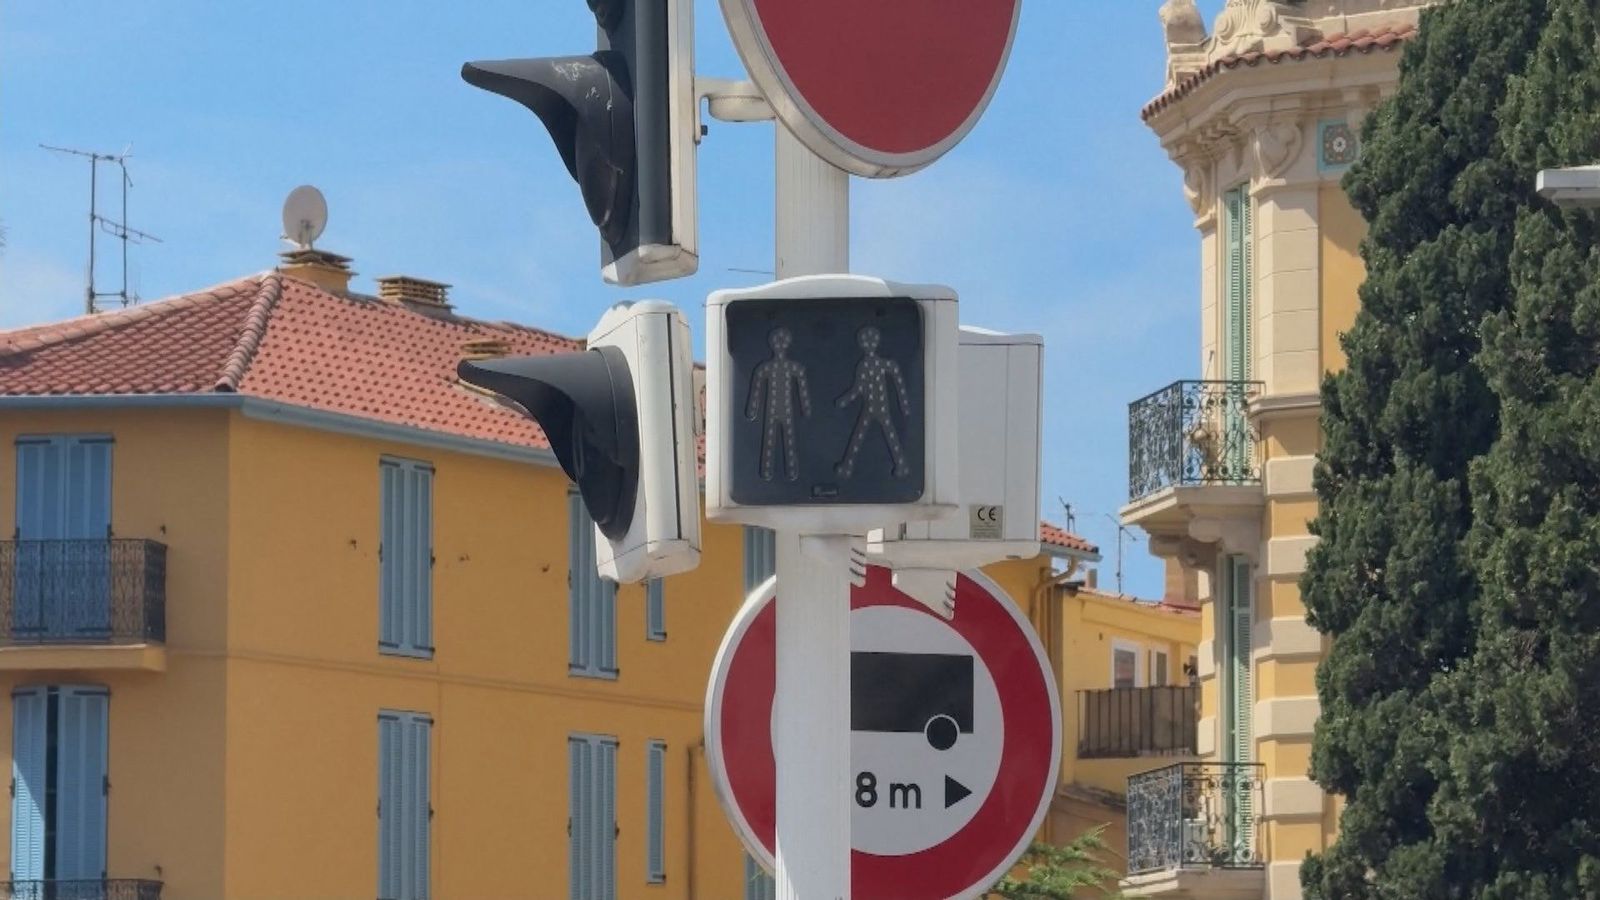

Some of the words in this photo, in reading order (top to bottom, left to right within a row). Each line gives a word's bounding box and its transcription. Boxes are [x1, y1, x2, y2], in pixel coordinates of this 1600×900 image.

[978, 507, 996, 521] CE
[855, 772, 877, 807] 8
[889, 783, 922, 809] m
